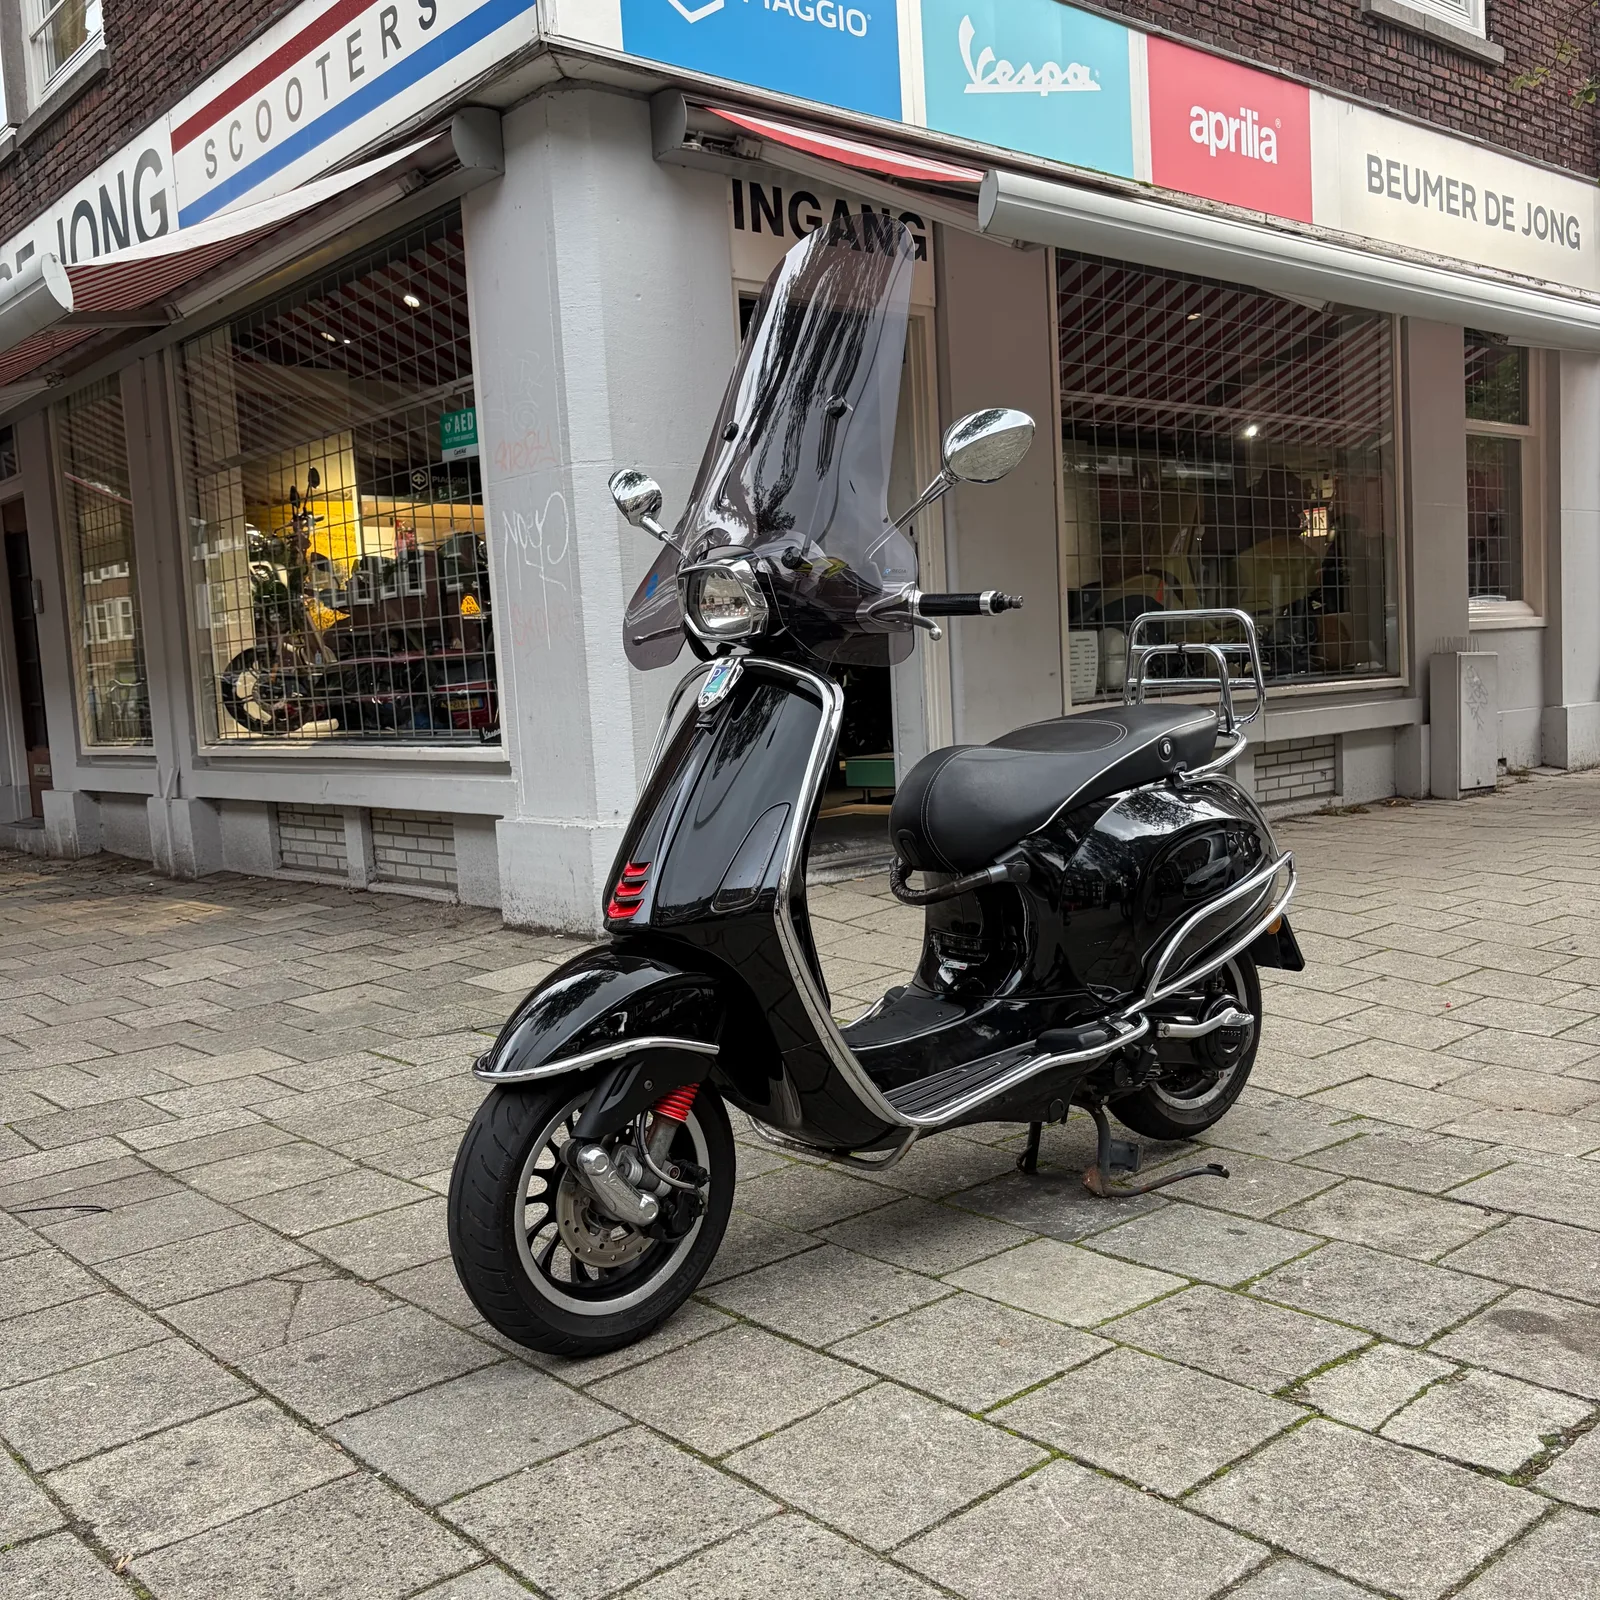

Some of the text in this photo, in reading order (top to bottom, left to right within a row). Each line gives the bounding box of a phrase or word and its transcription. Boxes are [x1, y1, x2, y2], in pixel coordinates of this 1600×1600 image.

[743, 0, 867, 37] AGGIO
[204, 0, 437, 180] SCOOTERS
[959, 15, 1101, 96] Vespa
[1190, 106, 1278, 164] aprilia
[732, 178, 927, 262] INGANG
[1367, 153, 1581, 250] BEUMER DE JONG
[454, 411, 474, 434] AED
[432, 475, 467, 484] PIAGGIO
